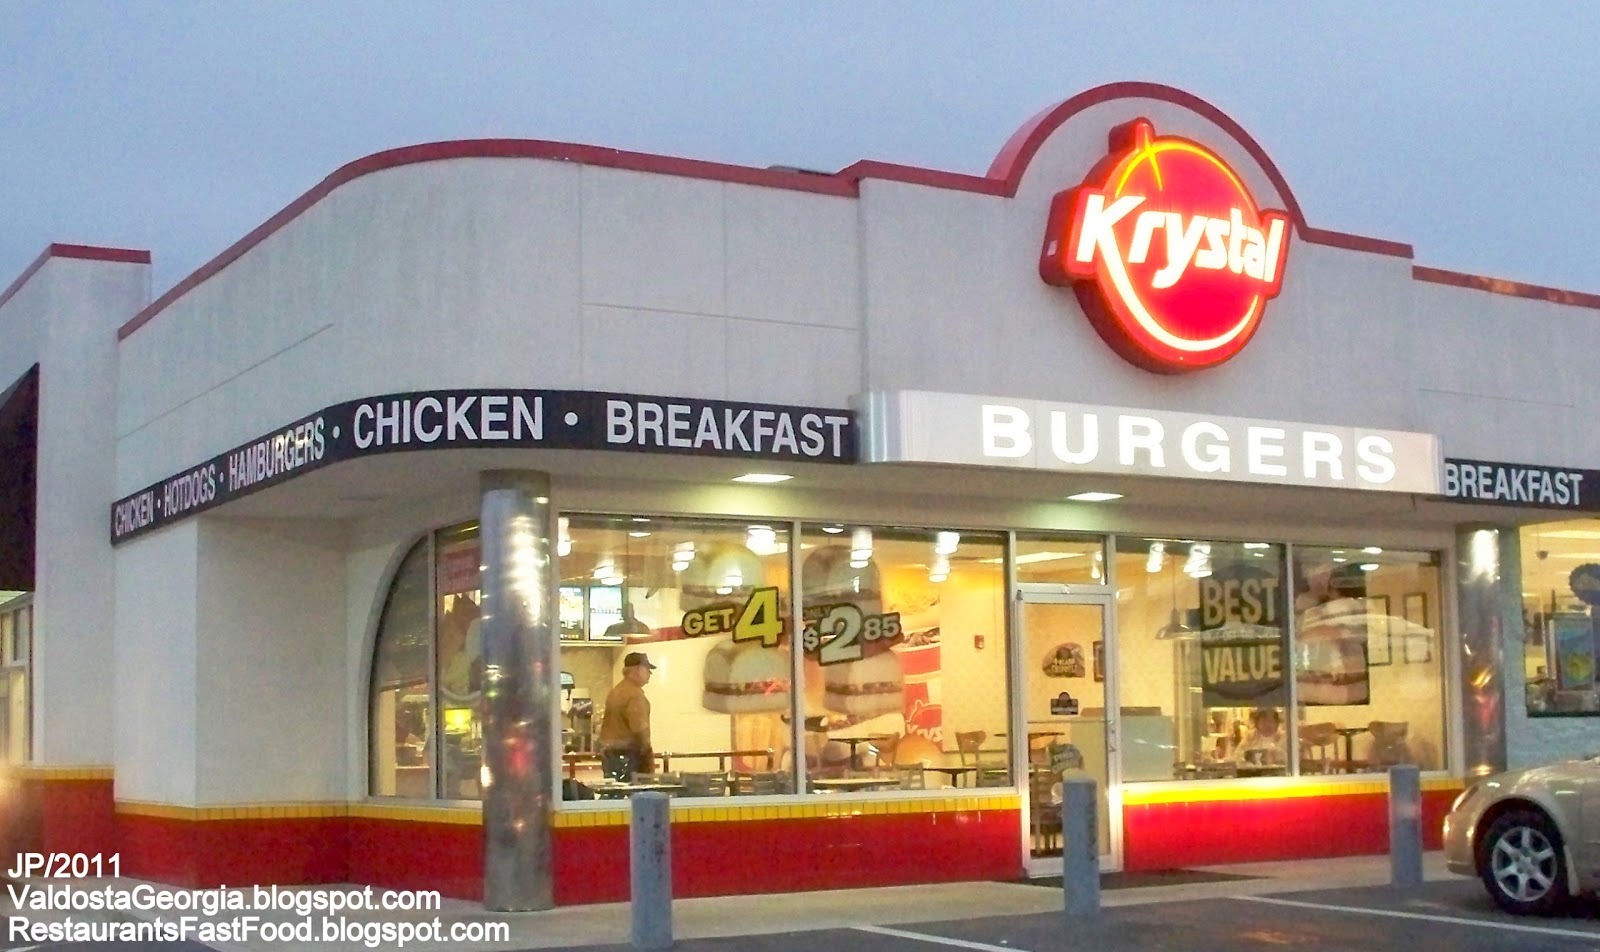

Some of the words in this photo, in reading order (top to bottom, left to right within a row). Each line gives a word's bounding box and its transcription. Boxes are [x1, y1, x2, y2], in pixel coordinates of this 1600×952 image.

[1076, 194, 1285, 289] Krystal
[114, 490, 154, 536] CHICKEN
[164, 463, 217, 518] HOTDOGS
[228, 417, 326, 491] HAMBURGERS
[353, 396, 544, 449] CHICKEN
[606, 399, 849, 457] BREAKFAST
[980, 404, 1397, 484] BURGERS
[1445, 463, 1583, 505] BREAKFAST
[683, 608, 734, 635] GET
[733, 588, 783, 647] 4
[1203, 578, 1279, 627] BEST
[1204, 644, 1281, 685] VALUE
